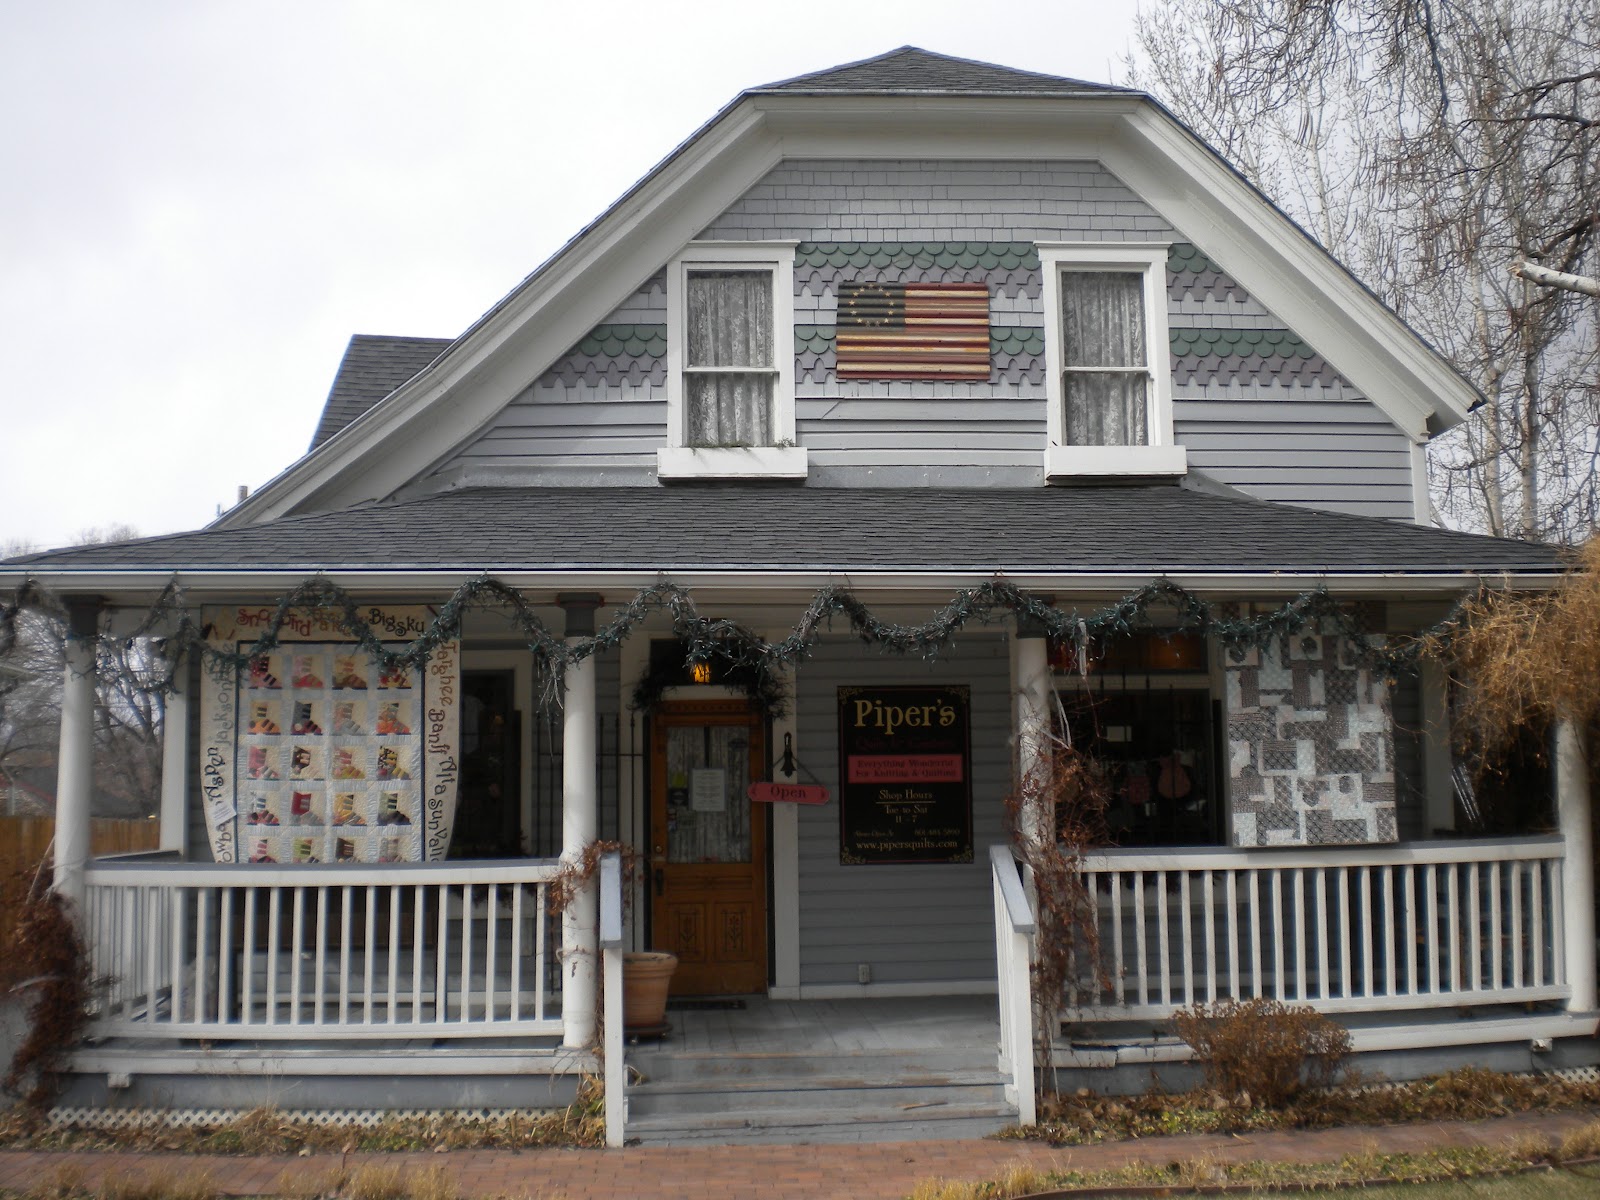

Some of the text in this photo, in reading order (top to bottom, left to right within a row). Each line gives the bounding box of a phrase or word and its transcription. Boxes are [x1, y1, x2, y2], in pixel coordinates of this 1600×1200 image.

[236, 608, 311, 637] Snobird
[368, 608, 395, 633] Big
[431, 641, 458, 706] Targhee
[428, 708, 450, 755] Banff
[854, 698, 956, 735] Piper's
[203, 747, 225, 801] Aspen
[434, 756, 457, 796] Alta
[857, 759, 953, 769] Everything Wonderful
[770, 786, 806, 800] Open
[879, 788, 933, 801] Shop Hours
[902, 806, 911, 814] to
[429, 828, 448, 862] Vall
[855, 837, 958, 852] www.pipersquilts.com
